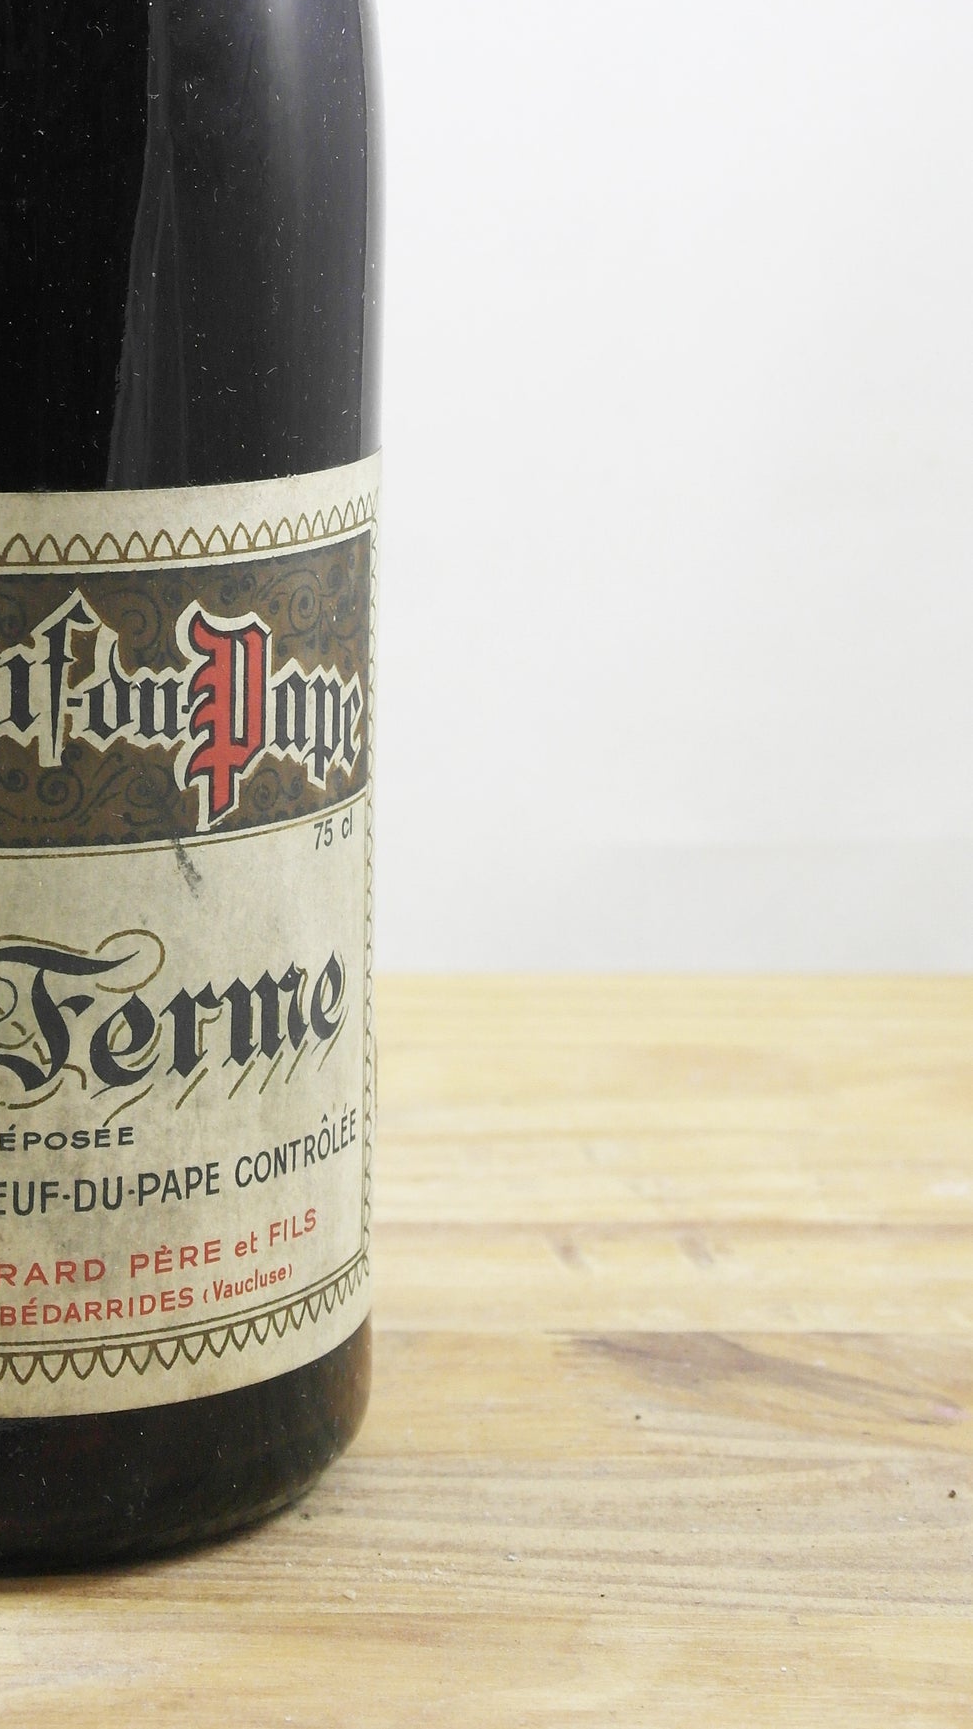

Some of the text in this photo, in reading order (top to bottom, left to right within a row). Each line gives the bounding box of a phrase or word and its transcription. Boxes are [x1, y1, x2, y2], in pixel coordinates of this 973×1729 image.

[313, 813, 354, 851] 75 cl
[234, 1103, 357, 1188] CONTRÔLÉE
[130, 1240, 221, 1279] PÈRE
[234, 1231, 258, 1258] et
[269, 1207, 317, 1247] FILS
[0, 1263, 293, 1328] BÉDARRIDES (Vaucluse)
